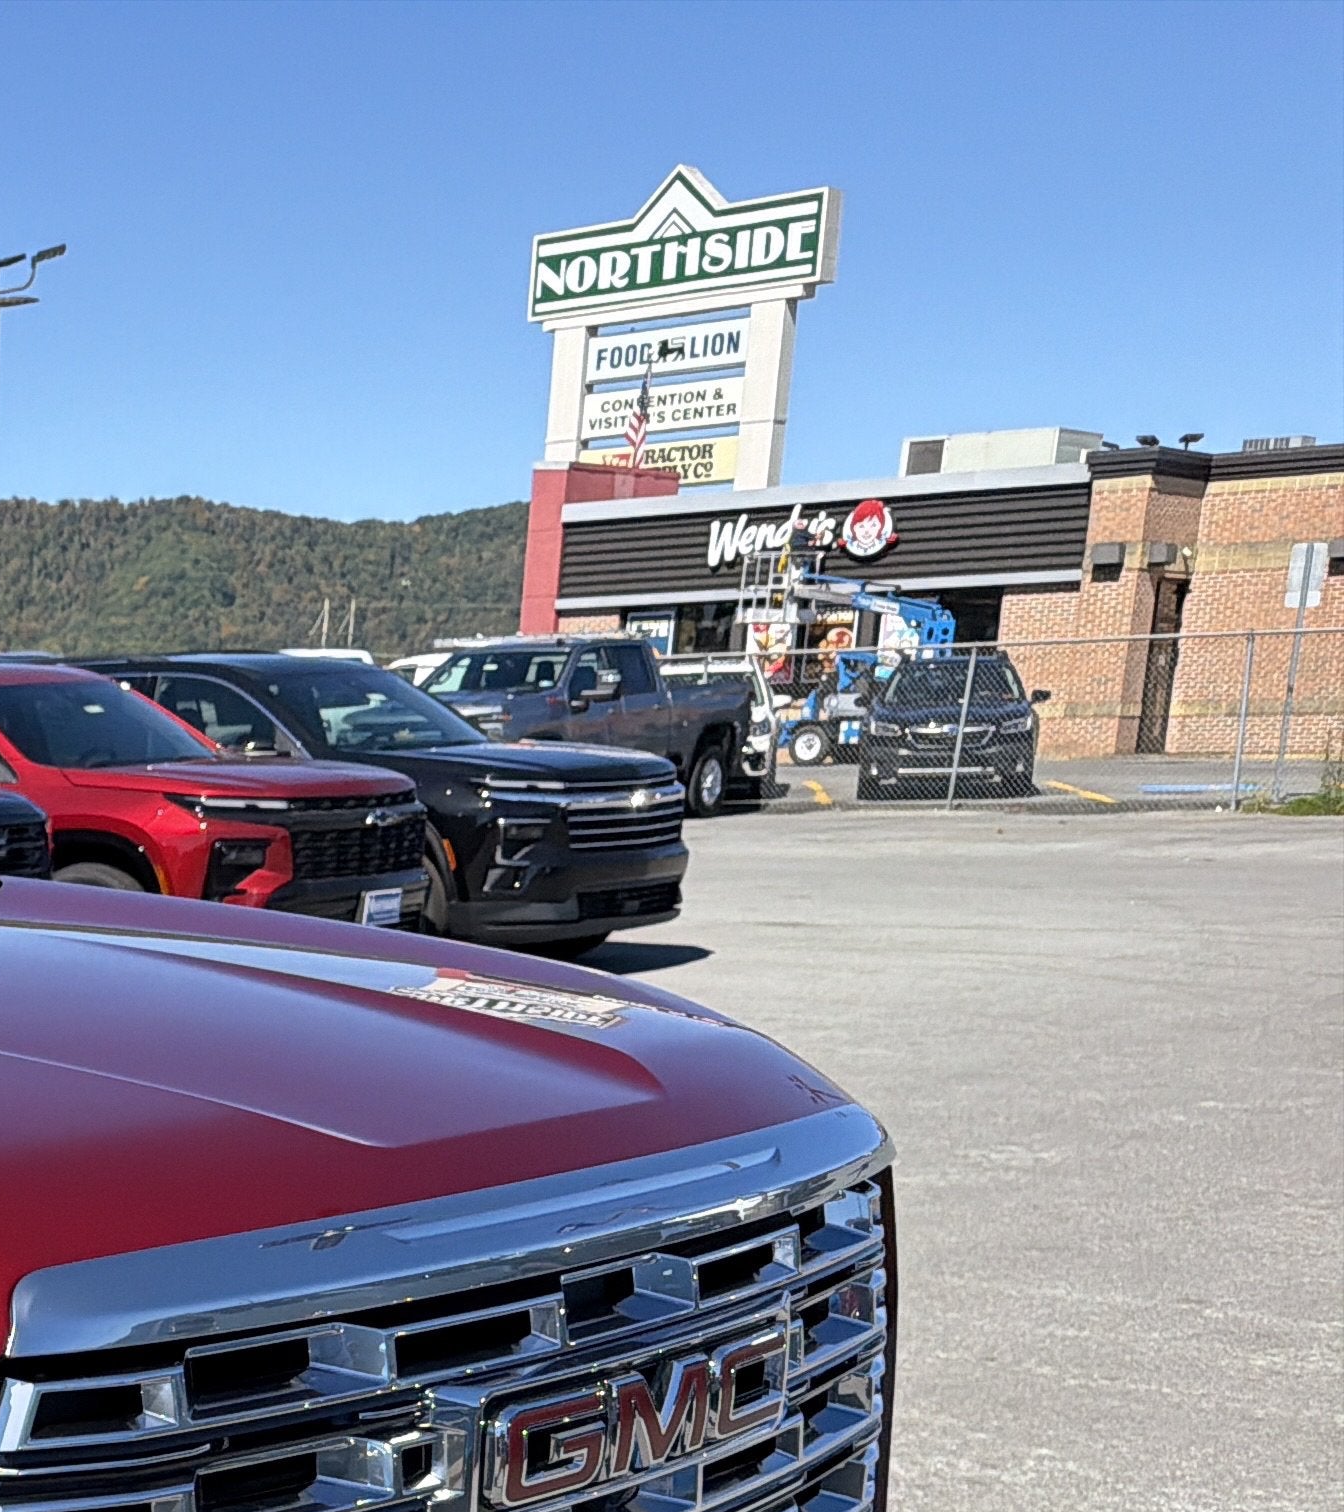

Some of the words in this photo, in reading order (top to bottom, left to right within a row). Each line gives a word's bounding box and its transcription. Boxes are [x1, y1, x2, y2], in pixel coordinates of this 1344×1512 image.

[535, 219, 817, 299] NORTHSIDE
[595, 342, 653, 372] FOOD
[689, 331, 741, 359] LION
[600, 389, 708, 413] CONENTION
[712, 387, 724, 401] &
[671, 402, 737, 421] CENTER
[642, 443, 714, 465] RACTOR
[502, 1323, 788, 1505] GMC
